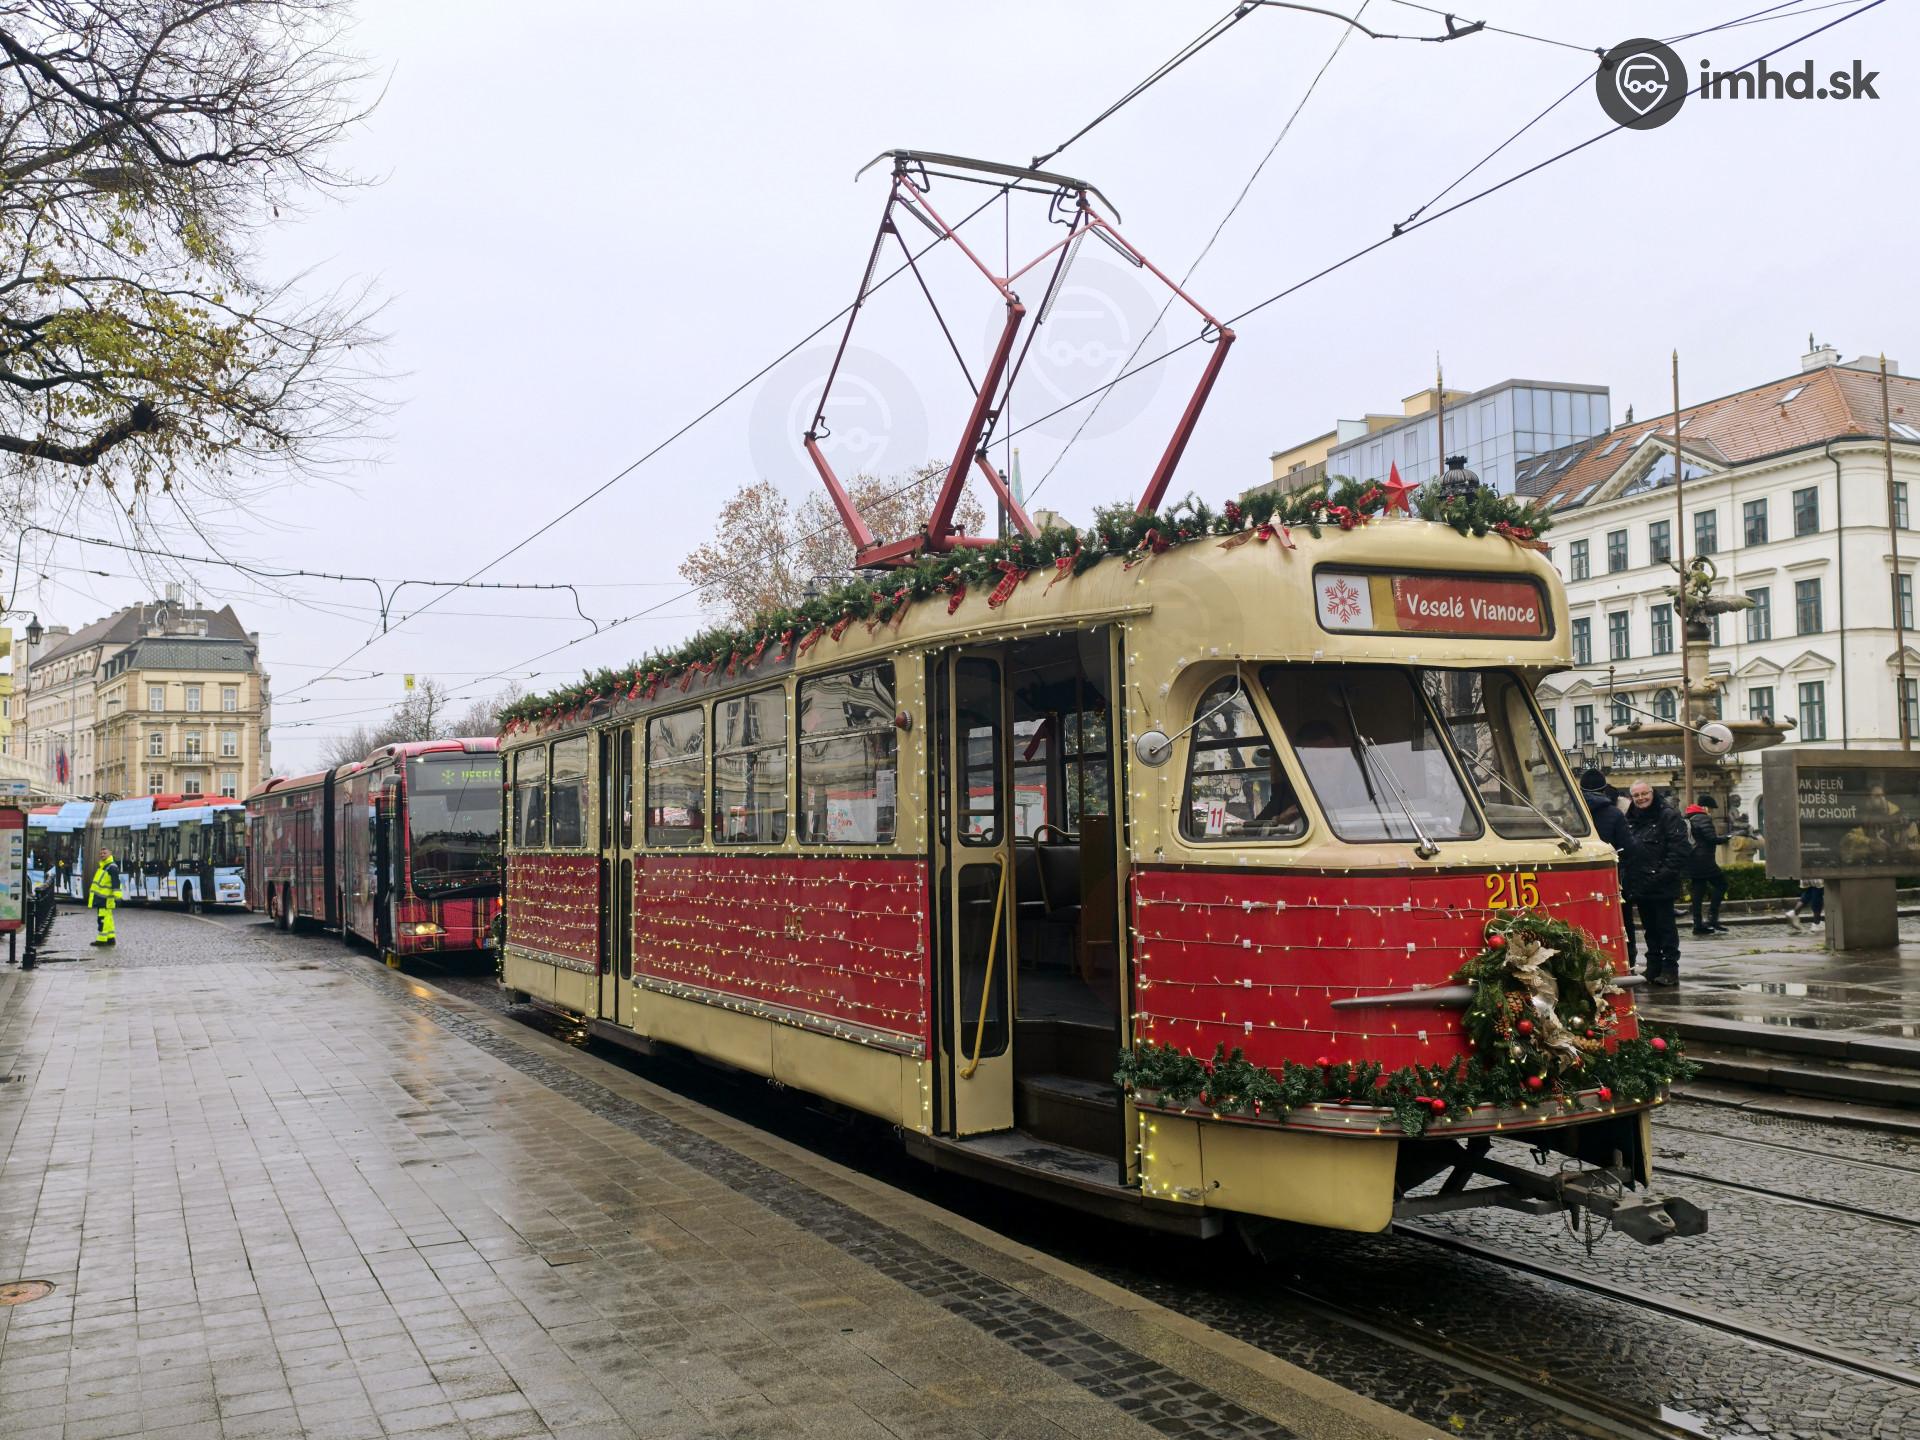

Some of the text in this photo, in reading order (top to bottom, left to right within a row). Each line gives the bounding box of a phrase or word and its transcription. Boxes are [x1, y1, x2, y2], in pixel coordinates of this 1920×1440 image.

[1406, 593, 1536, 623] Veselé Vianoce
[1799, 777, 1844, 790] AK JELEŇ
[1798, 791, 1838, 805] UDEŠ SI
[1210, 807, 1223, 828] 11
[1799, 805, 1857, 819] AM CHODIŤ
[1486, 872, 1539, 909] 215
